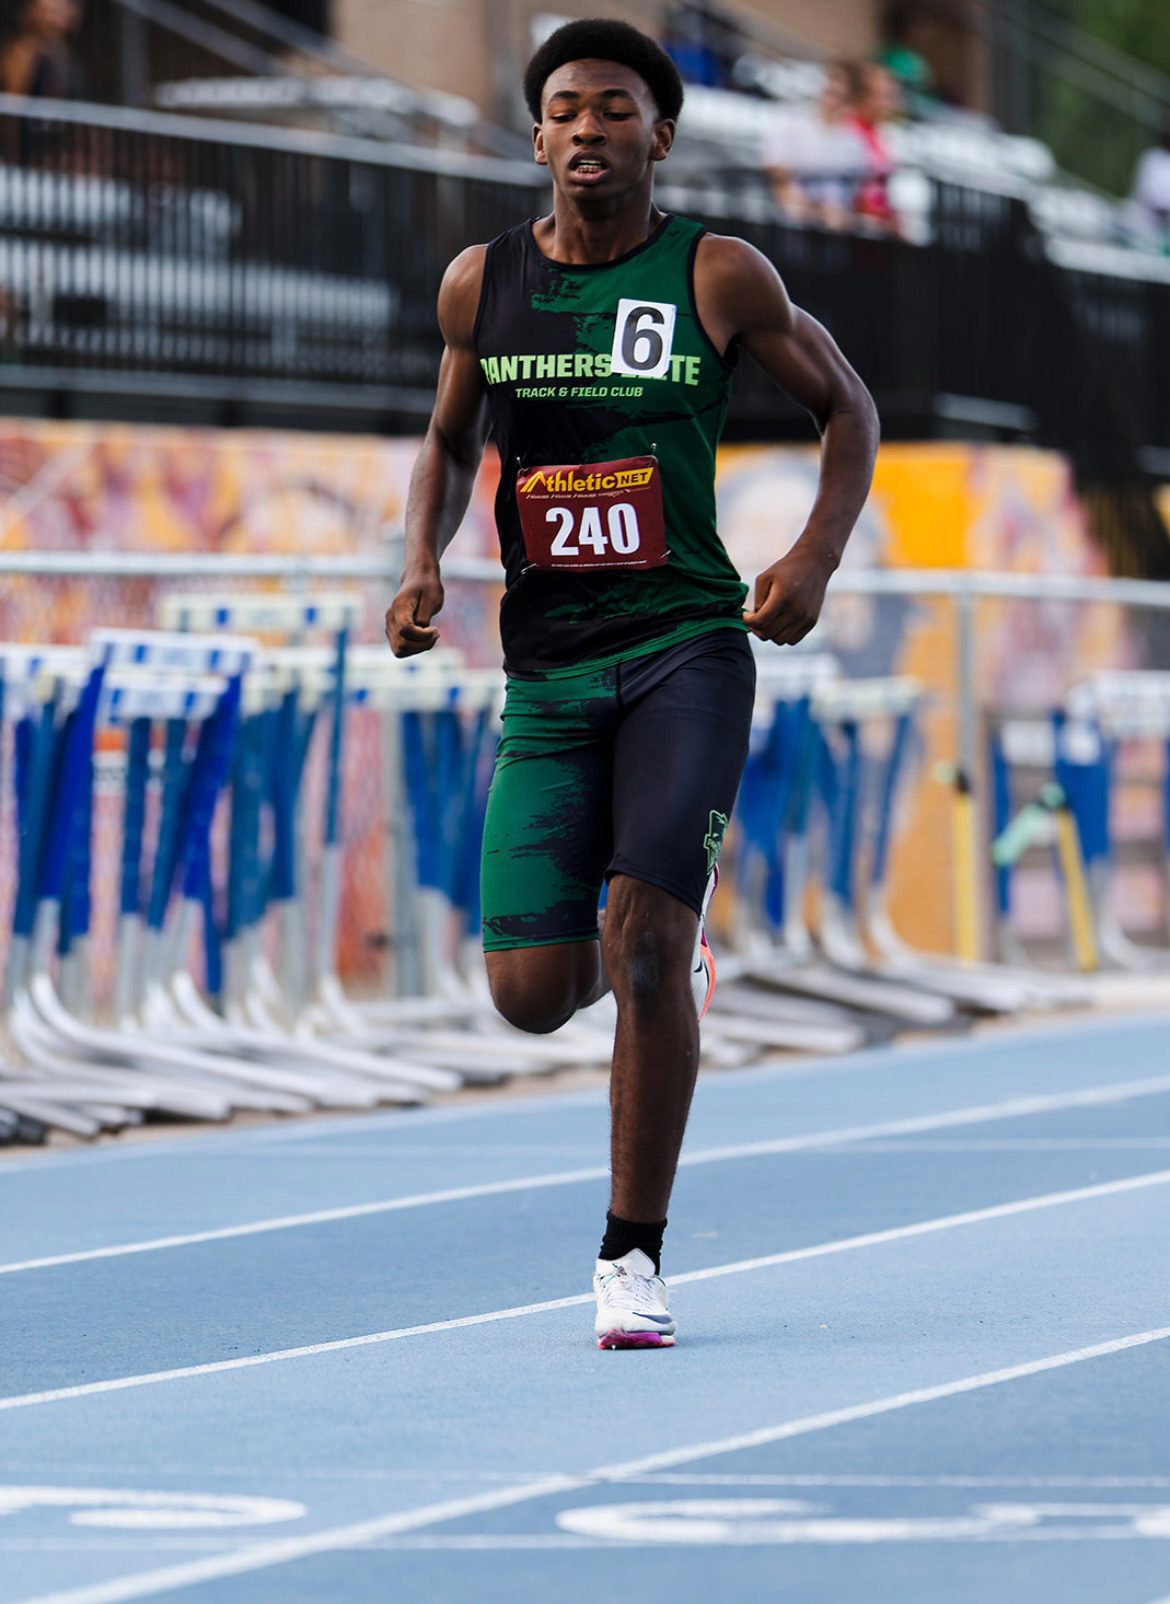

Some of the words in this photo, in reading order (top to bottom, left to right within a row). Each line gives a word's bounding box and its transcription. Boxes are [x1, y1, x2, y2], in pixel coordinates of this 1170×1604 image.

[621, 306, 665, 371] 6
[515, 386, 557, 398] TRACK
[558, 386, 568, 397] &
[570, 386, 609, 397] FIELD
[610, 386, 643, 397] CLUB
[545, 503, 640, 556] 240
